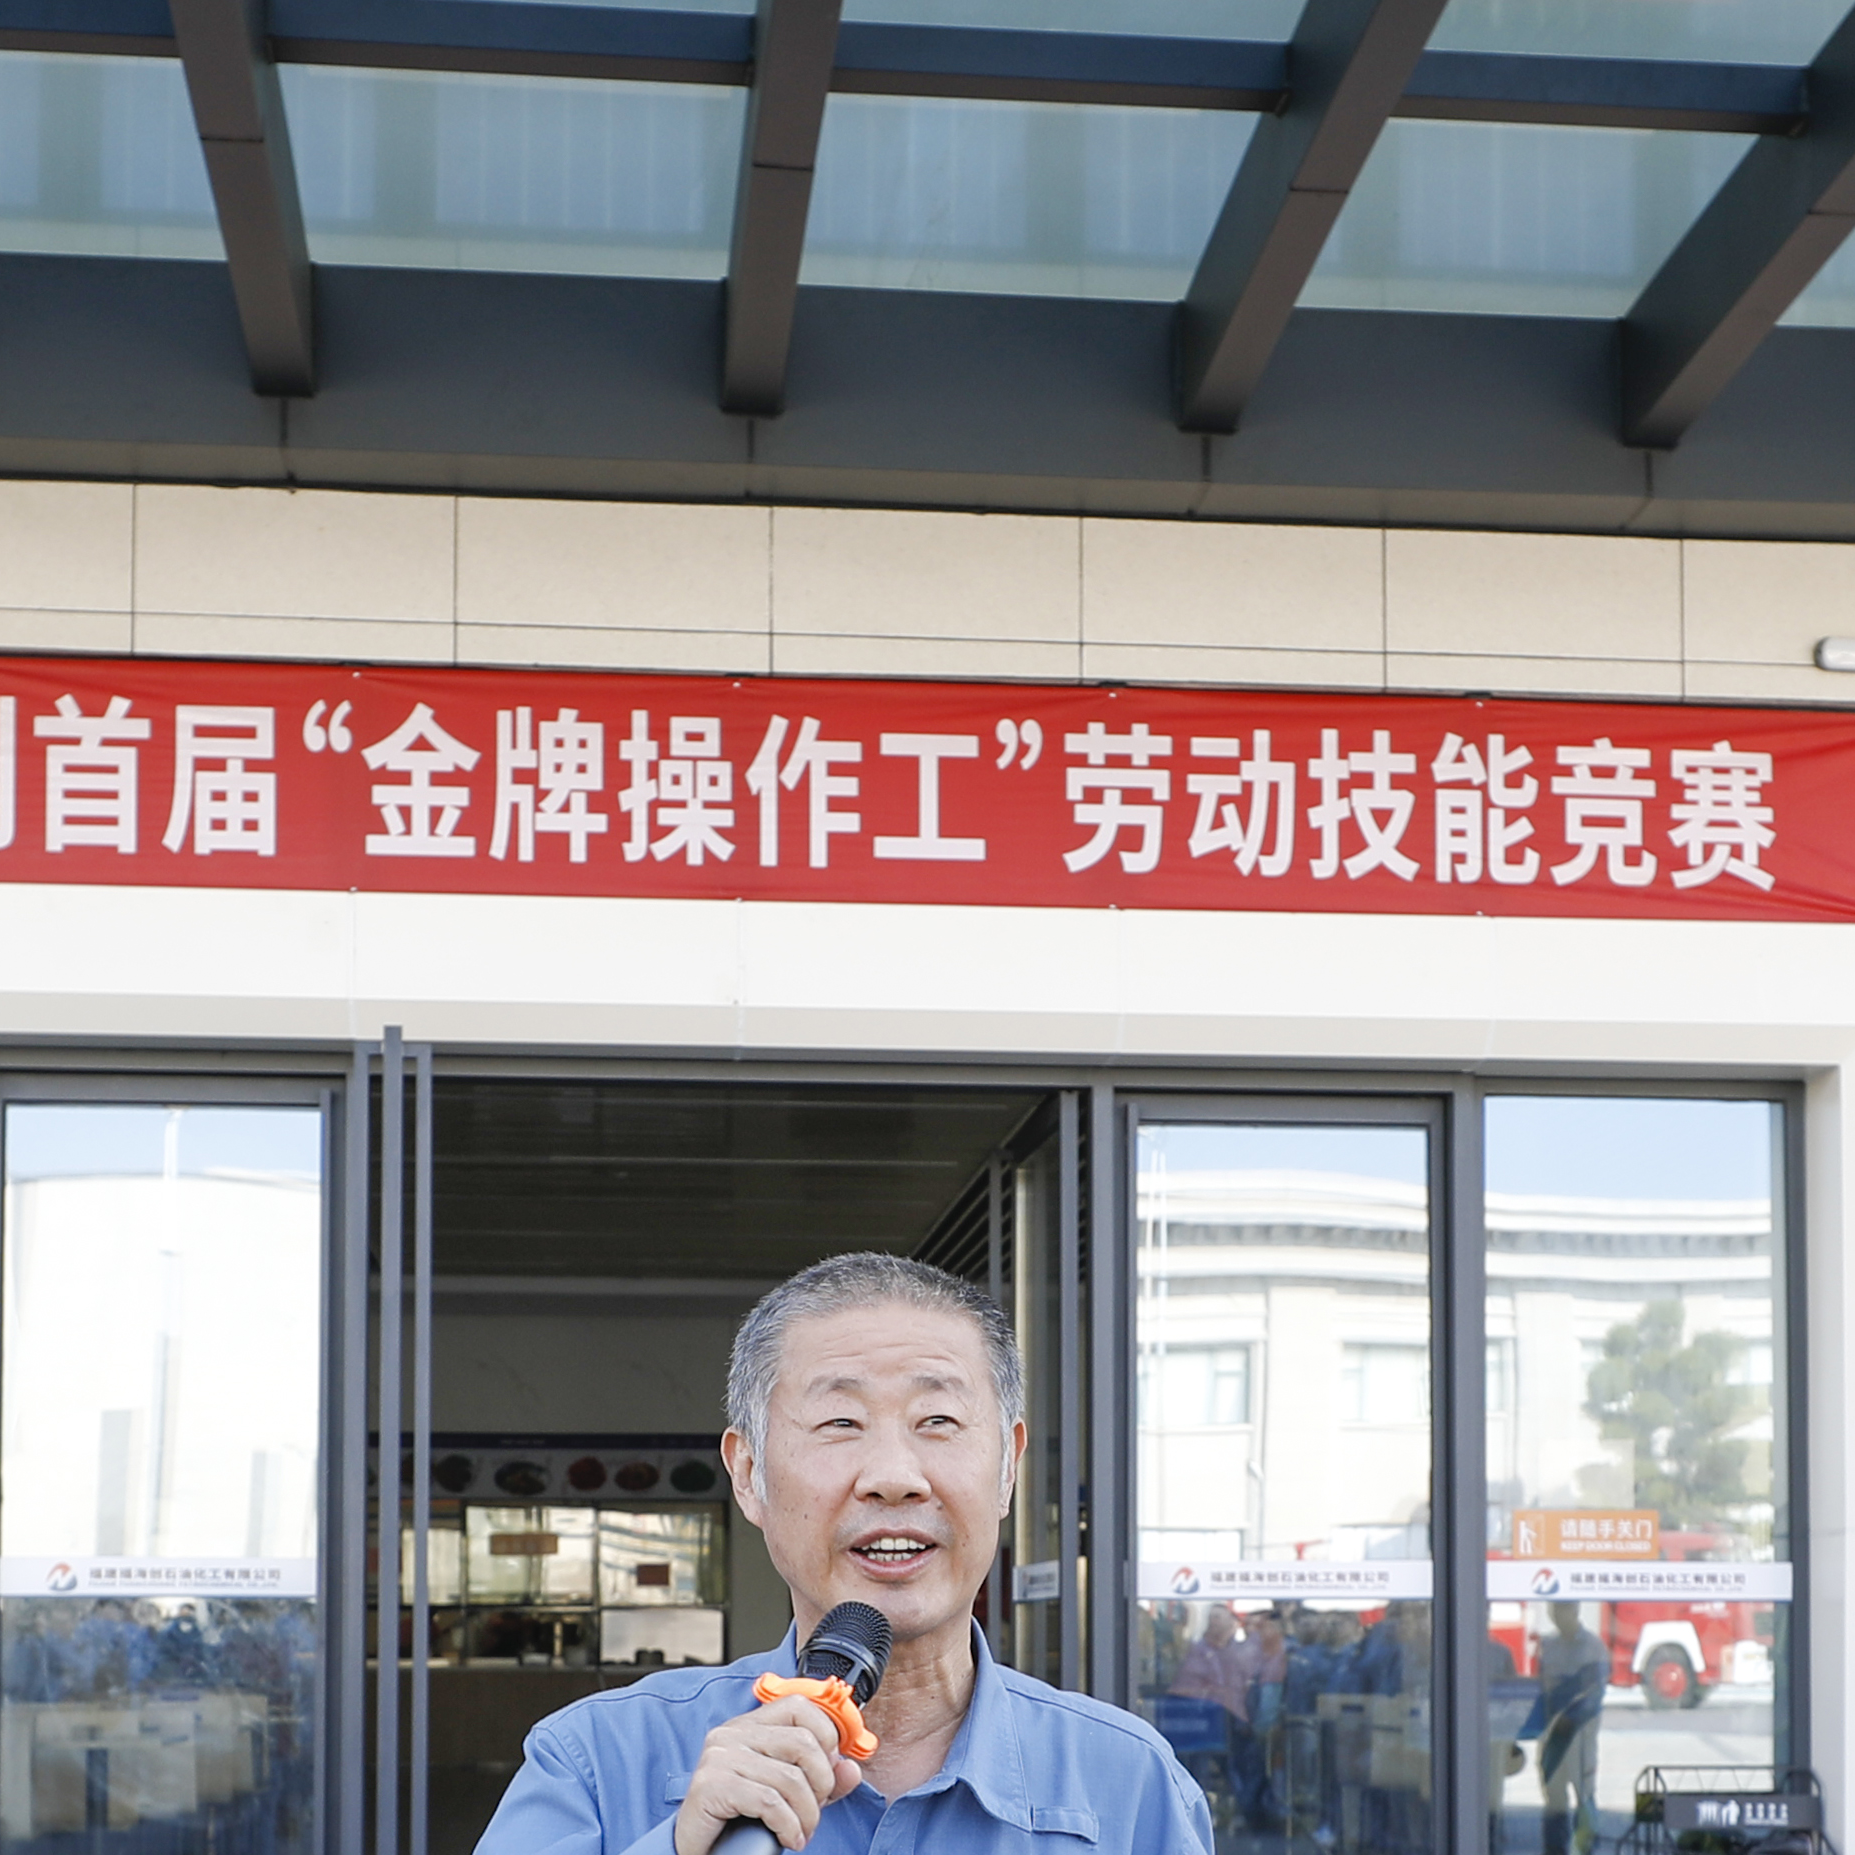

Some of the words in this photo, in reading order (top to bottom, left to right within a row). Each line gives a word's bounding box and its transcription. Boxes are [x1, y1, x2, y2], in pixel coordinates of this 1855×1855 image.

[1559, 1518, 1653, 1539] 请随手关门
[1560, 1540, 1585, 1552] KEEP
[1614, 1540, 1652, 1552] CLOSED
